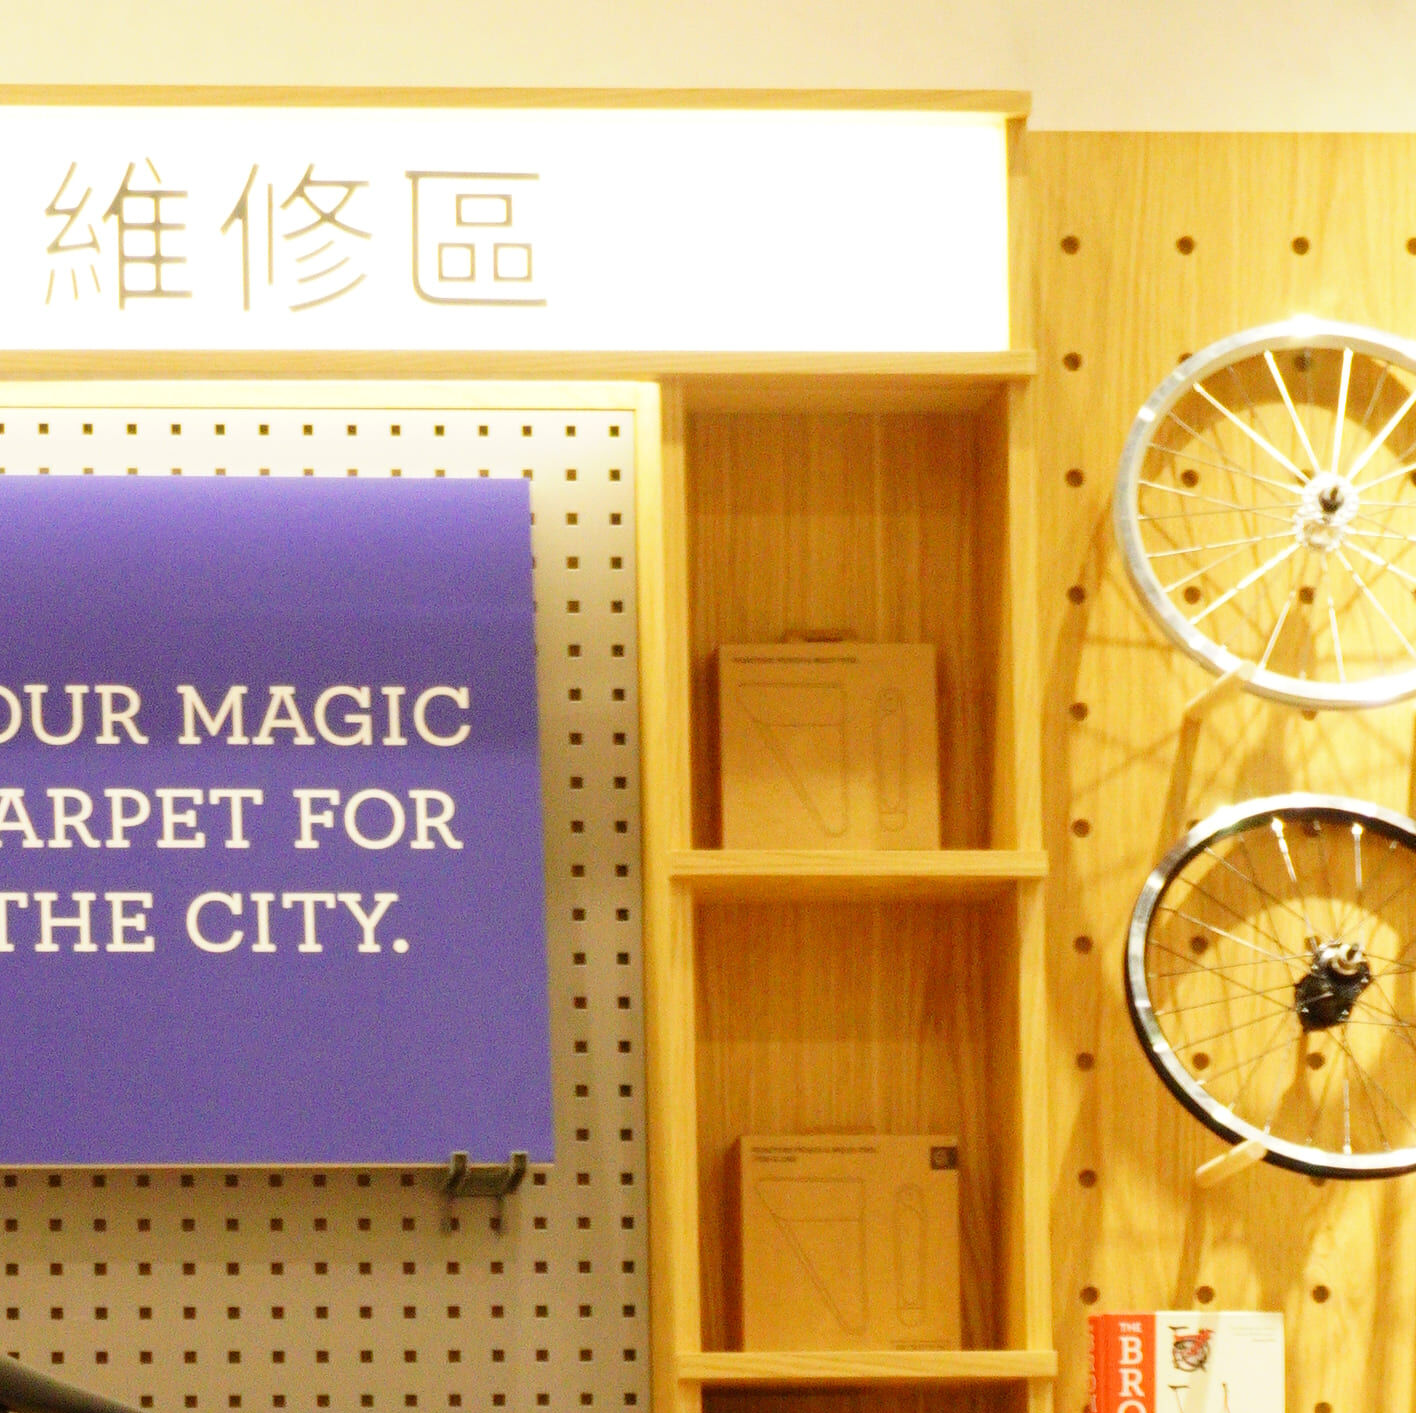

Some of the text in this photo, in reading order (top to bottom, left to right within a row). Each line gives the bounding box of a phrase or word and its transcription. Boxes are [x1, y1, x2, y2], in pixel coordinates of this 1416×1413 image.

[43, 156, 548, 313] 維修區
[177, 685, 472, 747] MAGIC
[292, 788, 464, 850] FOR
[185, 892, 411, 954] CITY.
[1119, 1322, 1142, 1333] THE
